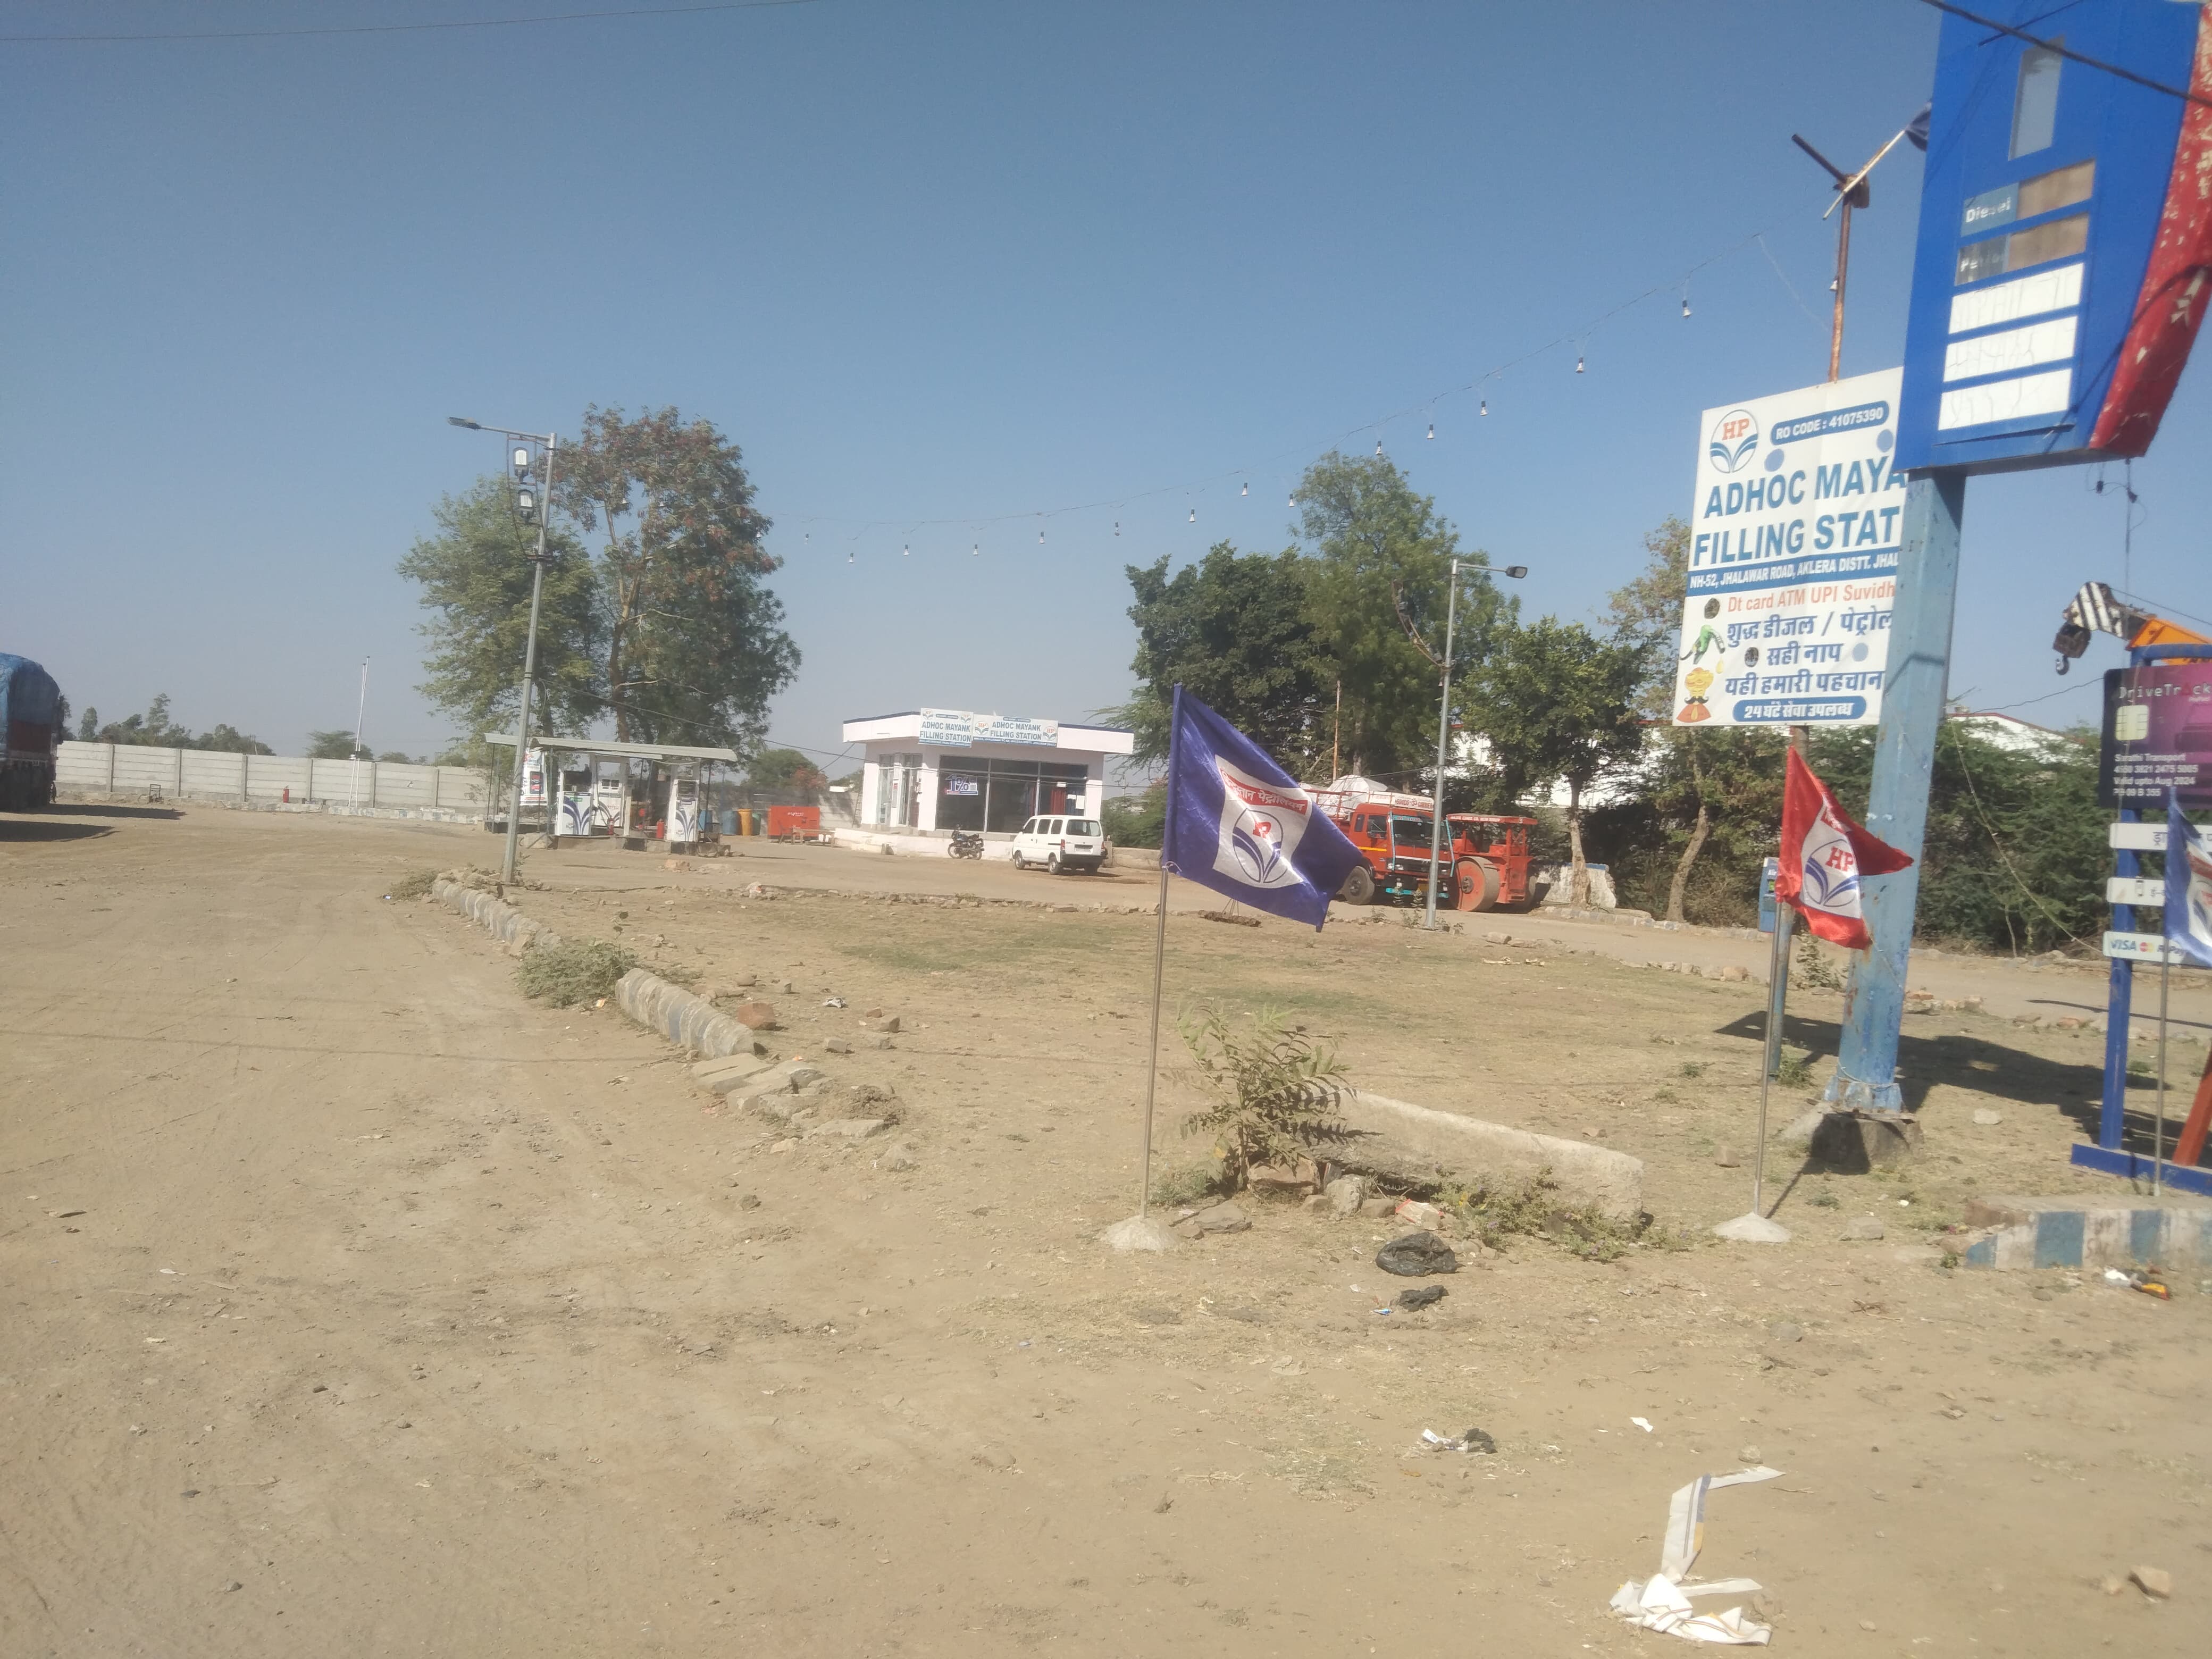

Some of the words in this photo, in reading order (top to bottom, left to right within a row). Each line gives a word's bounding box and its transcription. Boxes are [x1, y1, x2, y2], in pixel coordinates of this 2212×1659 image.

[1722, 418, 1749, 441] HP
[1776, 426, 1791, 440] RO
[1829, 407, 1884, 428] 41075390
[1704, 470, 1806, 519] ADHOC
[1694, 518, 1804, 567] FILLING
[1814, 506, 1900, 550] STAT
[1720, 567, 1770, 585] JHALAWAR
[1797, 559, 1836, 577] AKLERA
[1728, 596, 1741, 613] Dt
[1746, 593, 1773, 610] card
[1778, 588, 1805, 607] ATM
[1811, 585, 1838, 604] UPI
[1842, 581, 1896, 601] Suvidh
[1727, 621, 1761, 648] शुद्ध
[1763, 614, 1817, 638] डीजल
[1767, 641, 1800, 665] सही
[1804, 643, 1844, 663] नाप
[1725, 672, 1758, 696] यही
[1759, 668, 1813, 694] हमारी
[1816, 671, 1885, 692] पहचान
[1782, 700, 1807, 717] सेवा
[1807, 703, 1855, 717] उपलब्ध
[920, 731, 944, 740] FILLING
[945, 733, 971, 742] STATION
[921, 721, 944, 730] ADHOC
[945, 723, 970, 732] MAYANK
[1825, 846, 1854, 872] HP
[2111, 940, 2136, 950] VISA
